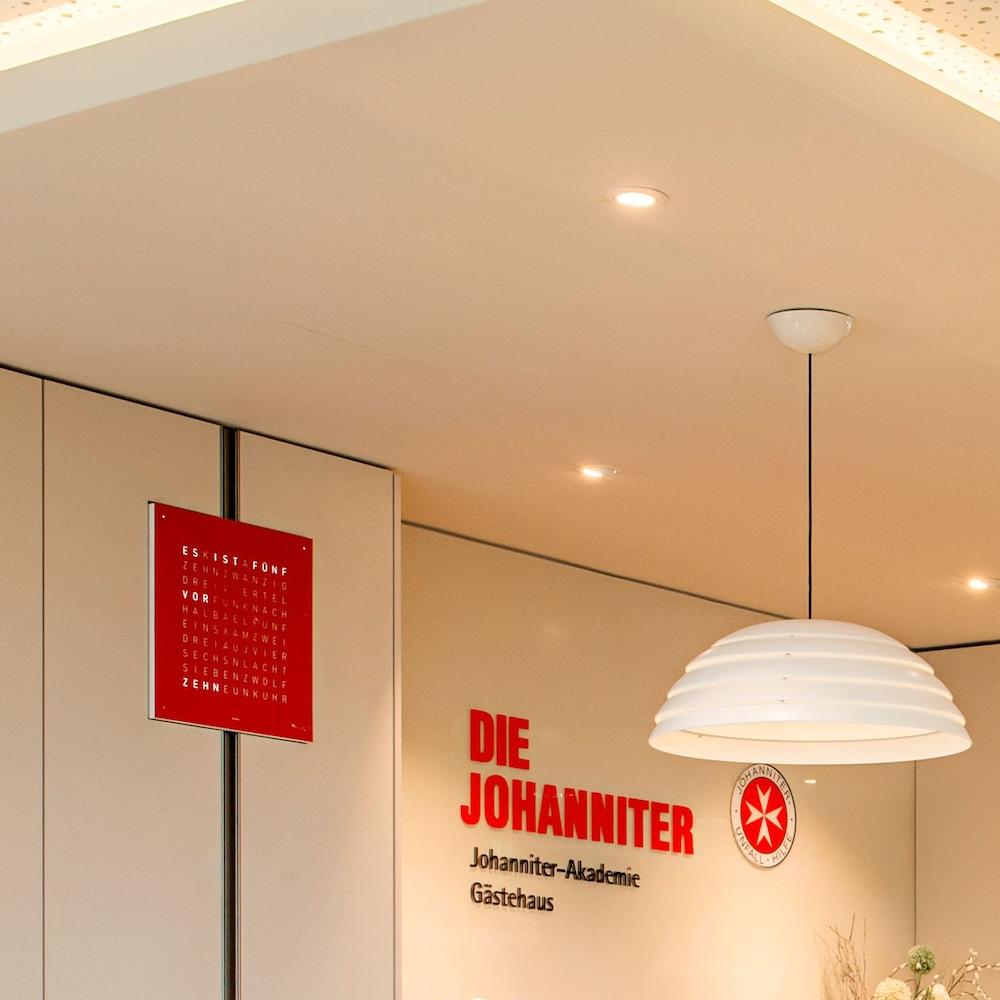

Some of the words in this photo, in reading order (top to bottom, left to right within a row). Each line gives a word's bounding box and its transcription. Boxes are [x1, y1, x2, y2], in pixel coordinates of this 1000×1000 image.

[470, 709, 530, 770] DIE
[460, 772, 695, 855] JOHANNITER
[470, 847, 640, 888] Johanniter-Akademie
[470, 882, 554, 912] Gästehaus
